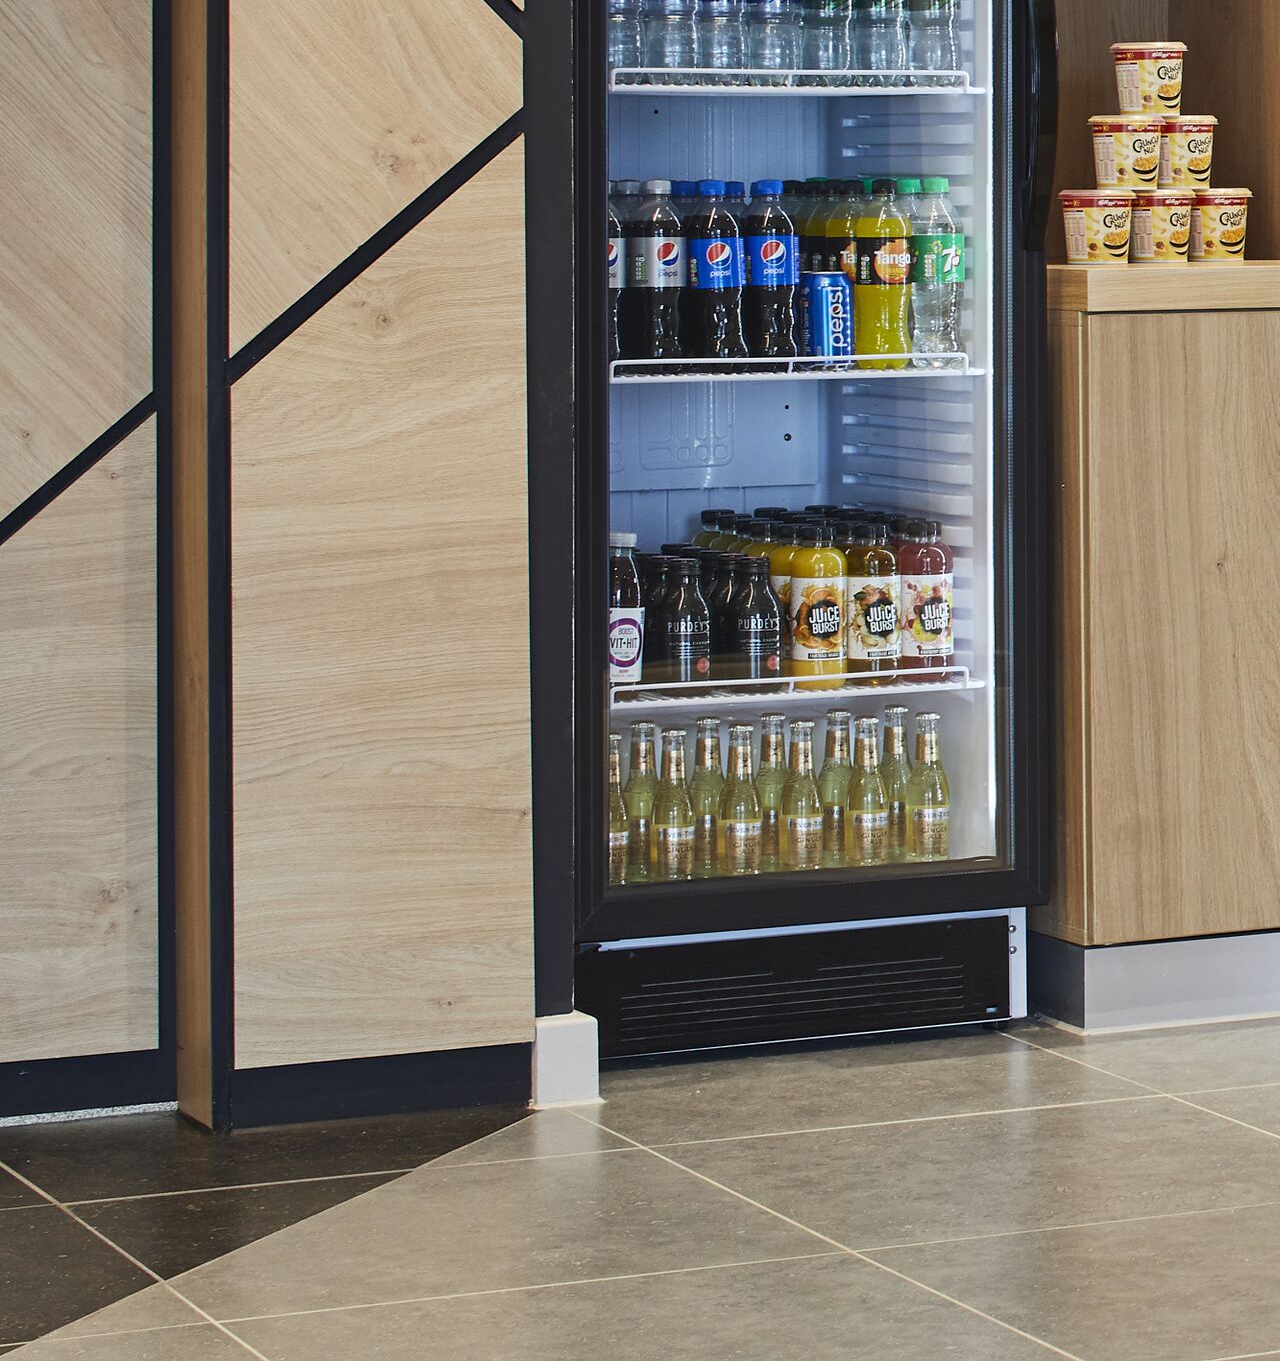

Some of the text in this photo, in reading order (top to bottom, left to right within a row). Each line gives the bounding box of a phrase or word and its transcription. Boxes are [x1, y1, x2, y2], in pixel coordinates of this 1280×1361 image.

[874, 250, 911, 266] Tango
[658, 269, 678, 278] pepsi
[710, 269, 731, 278] pepsi
[764, 267, 785, 276] pepsi
[828, 286, 848, 348] pepsi
[812, 621, 839, 635] BURST
[870, 620, 896, 633] BURST
[925, 617, 949, 631] BURST
